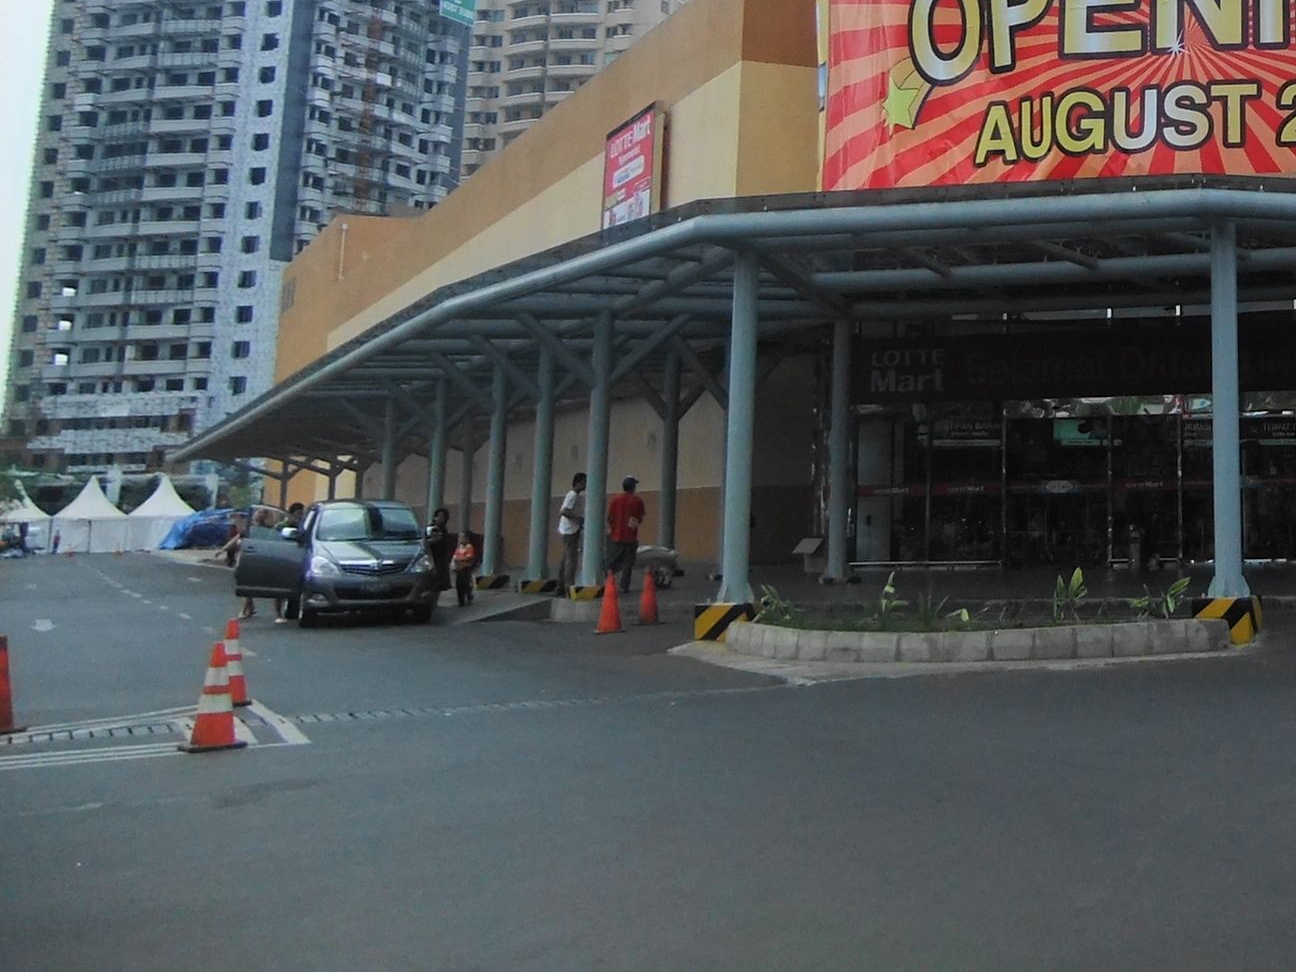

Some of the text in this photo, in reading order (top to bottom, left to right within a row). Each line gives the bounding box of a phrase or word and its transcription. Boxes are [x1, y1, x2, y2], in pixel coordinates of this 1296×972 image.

[975, 82, 1259, 166] AUGUST
[871, 348, 946, 368] LOTTE
[869, 369, 946, 393] Mart
